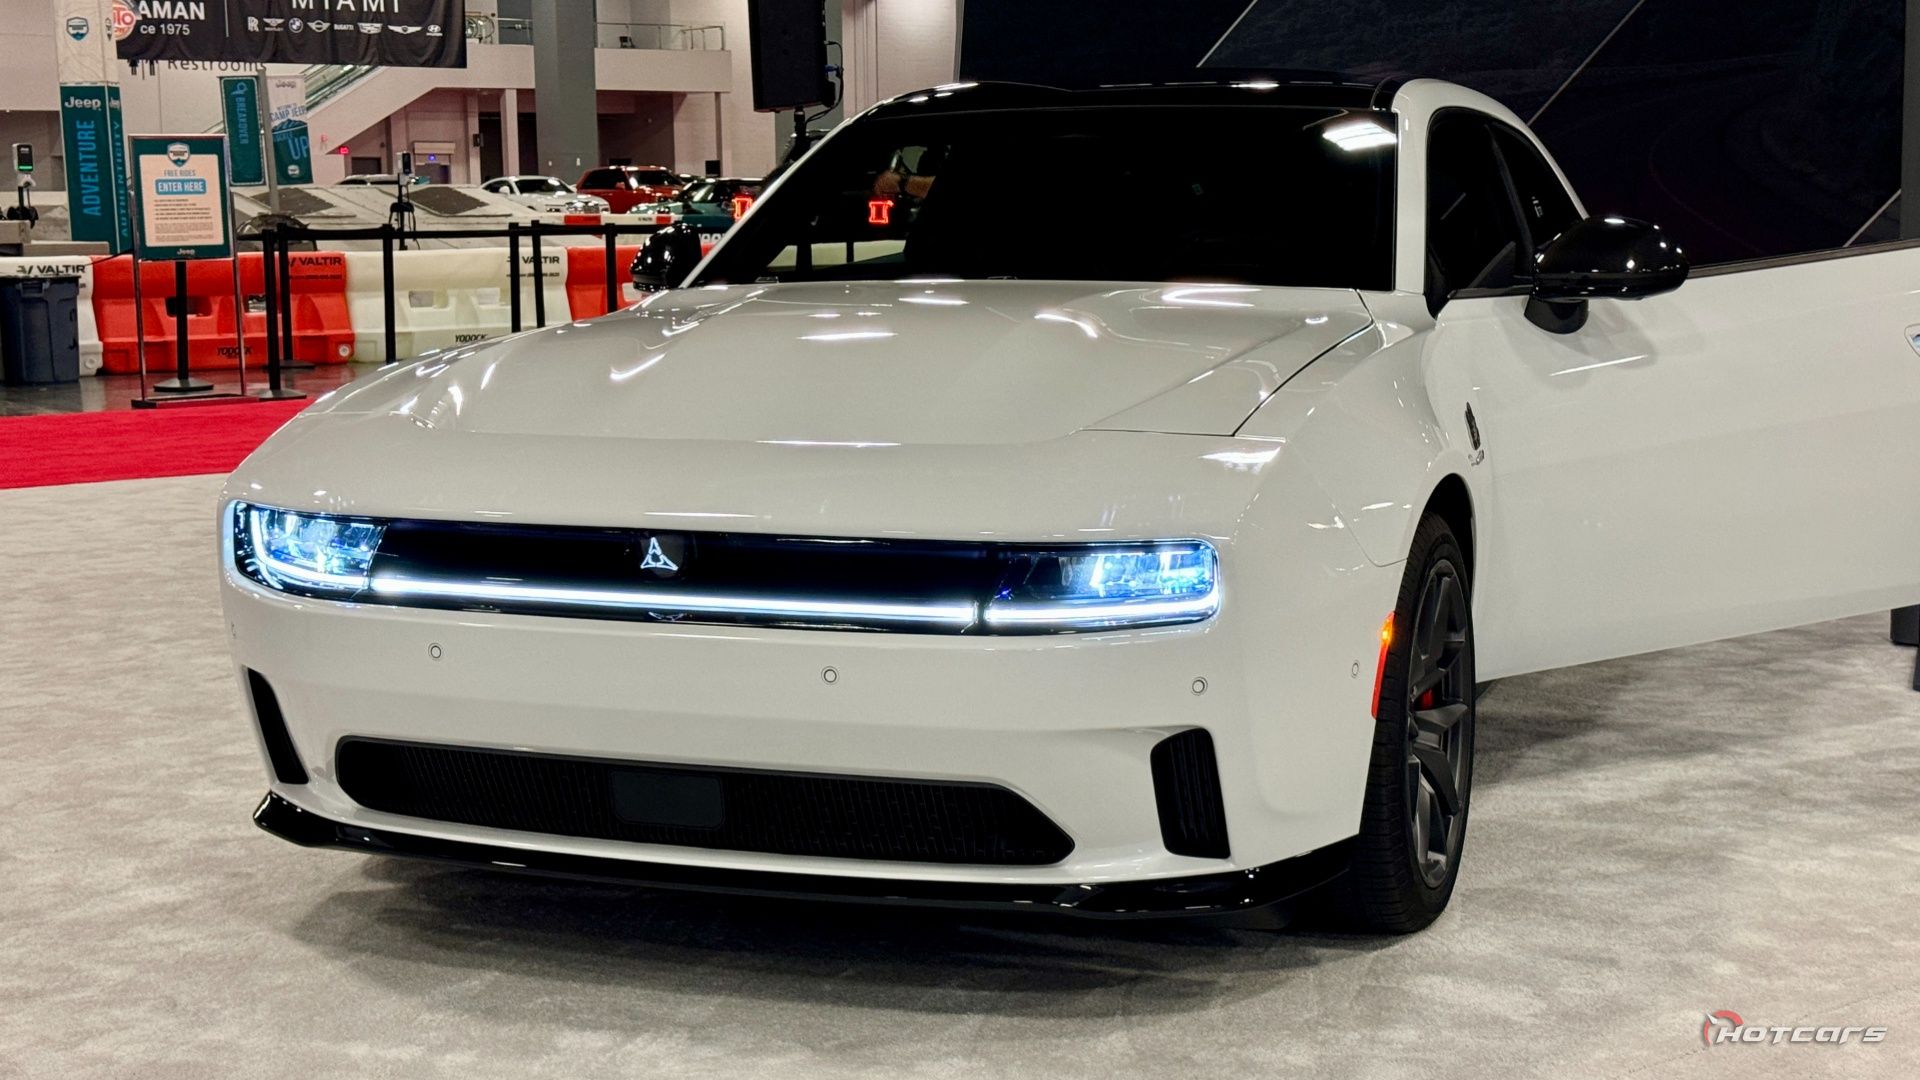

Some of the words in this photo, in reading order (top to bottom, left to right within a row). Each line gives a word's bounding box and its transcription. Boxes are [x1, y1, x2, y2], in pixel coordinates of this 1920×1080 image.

[160, 23, 191, 35] 1975
[64, 96, 101, 110] Jeep
[76, 120, 101, 216] ADVENTURE
[158, 182, 183, 192] ENTER
[184, 181, 204, 192] HERE
[298, 256, 342, 266] VALTIR
[37, 264, 86, 274] VALTIR
